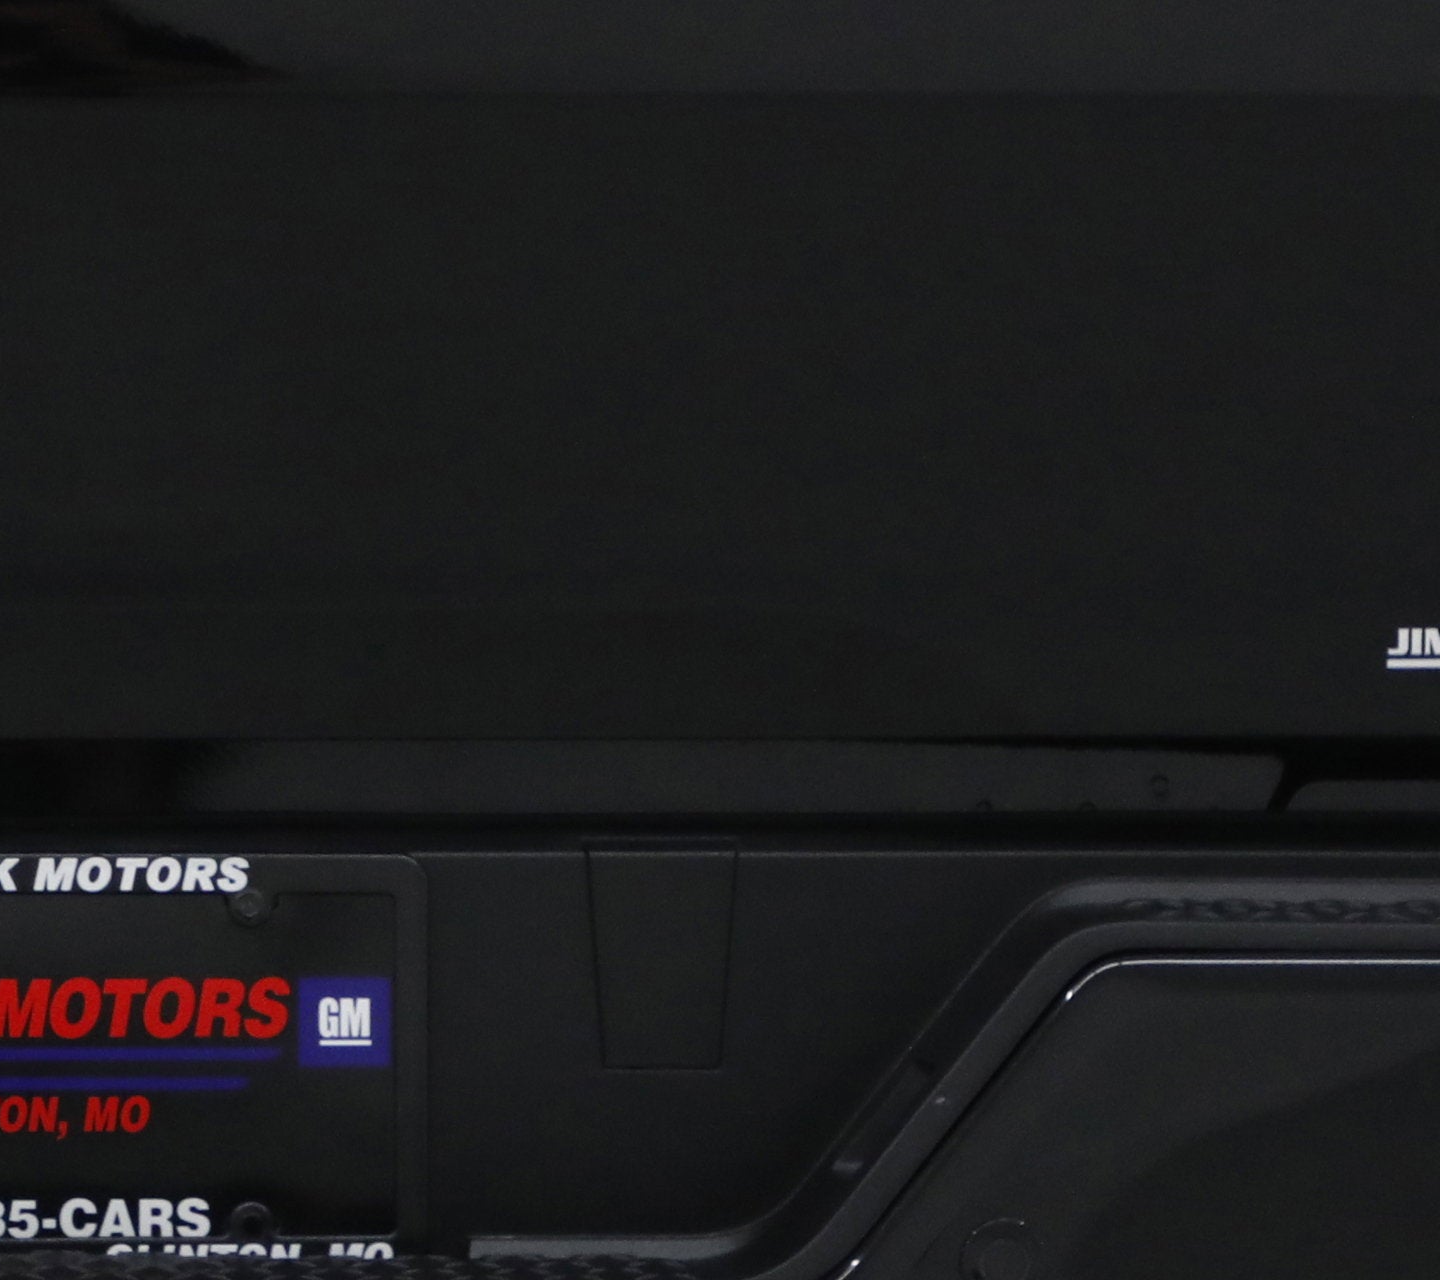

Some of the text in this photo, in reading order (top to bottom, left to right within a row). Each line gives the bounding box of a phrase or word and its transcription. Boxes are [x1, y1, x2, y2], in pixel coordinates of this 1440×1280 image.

[32, 856, 250, 893] MOTORS
[318, 996, 371, 1040] GM
[83, 1095, 151, 1133] MO
